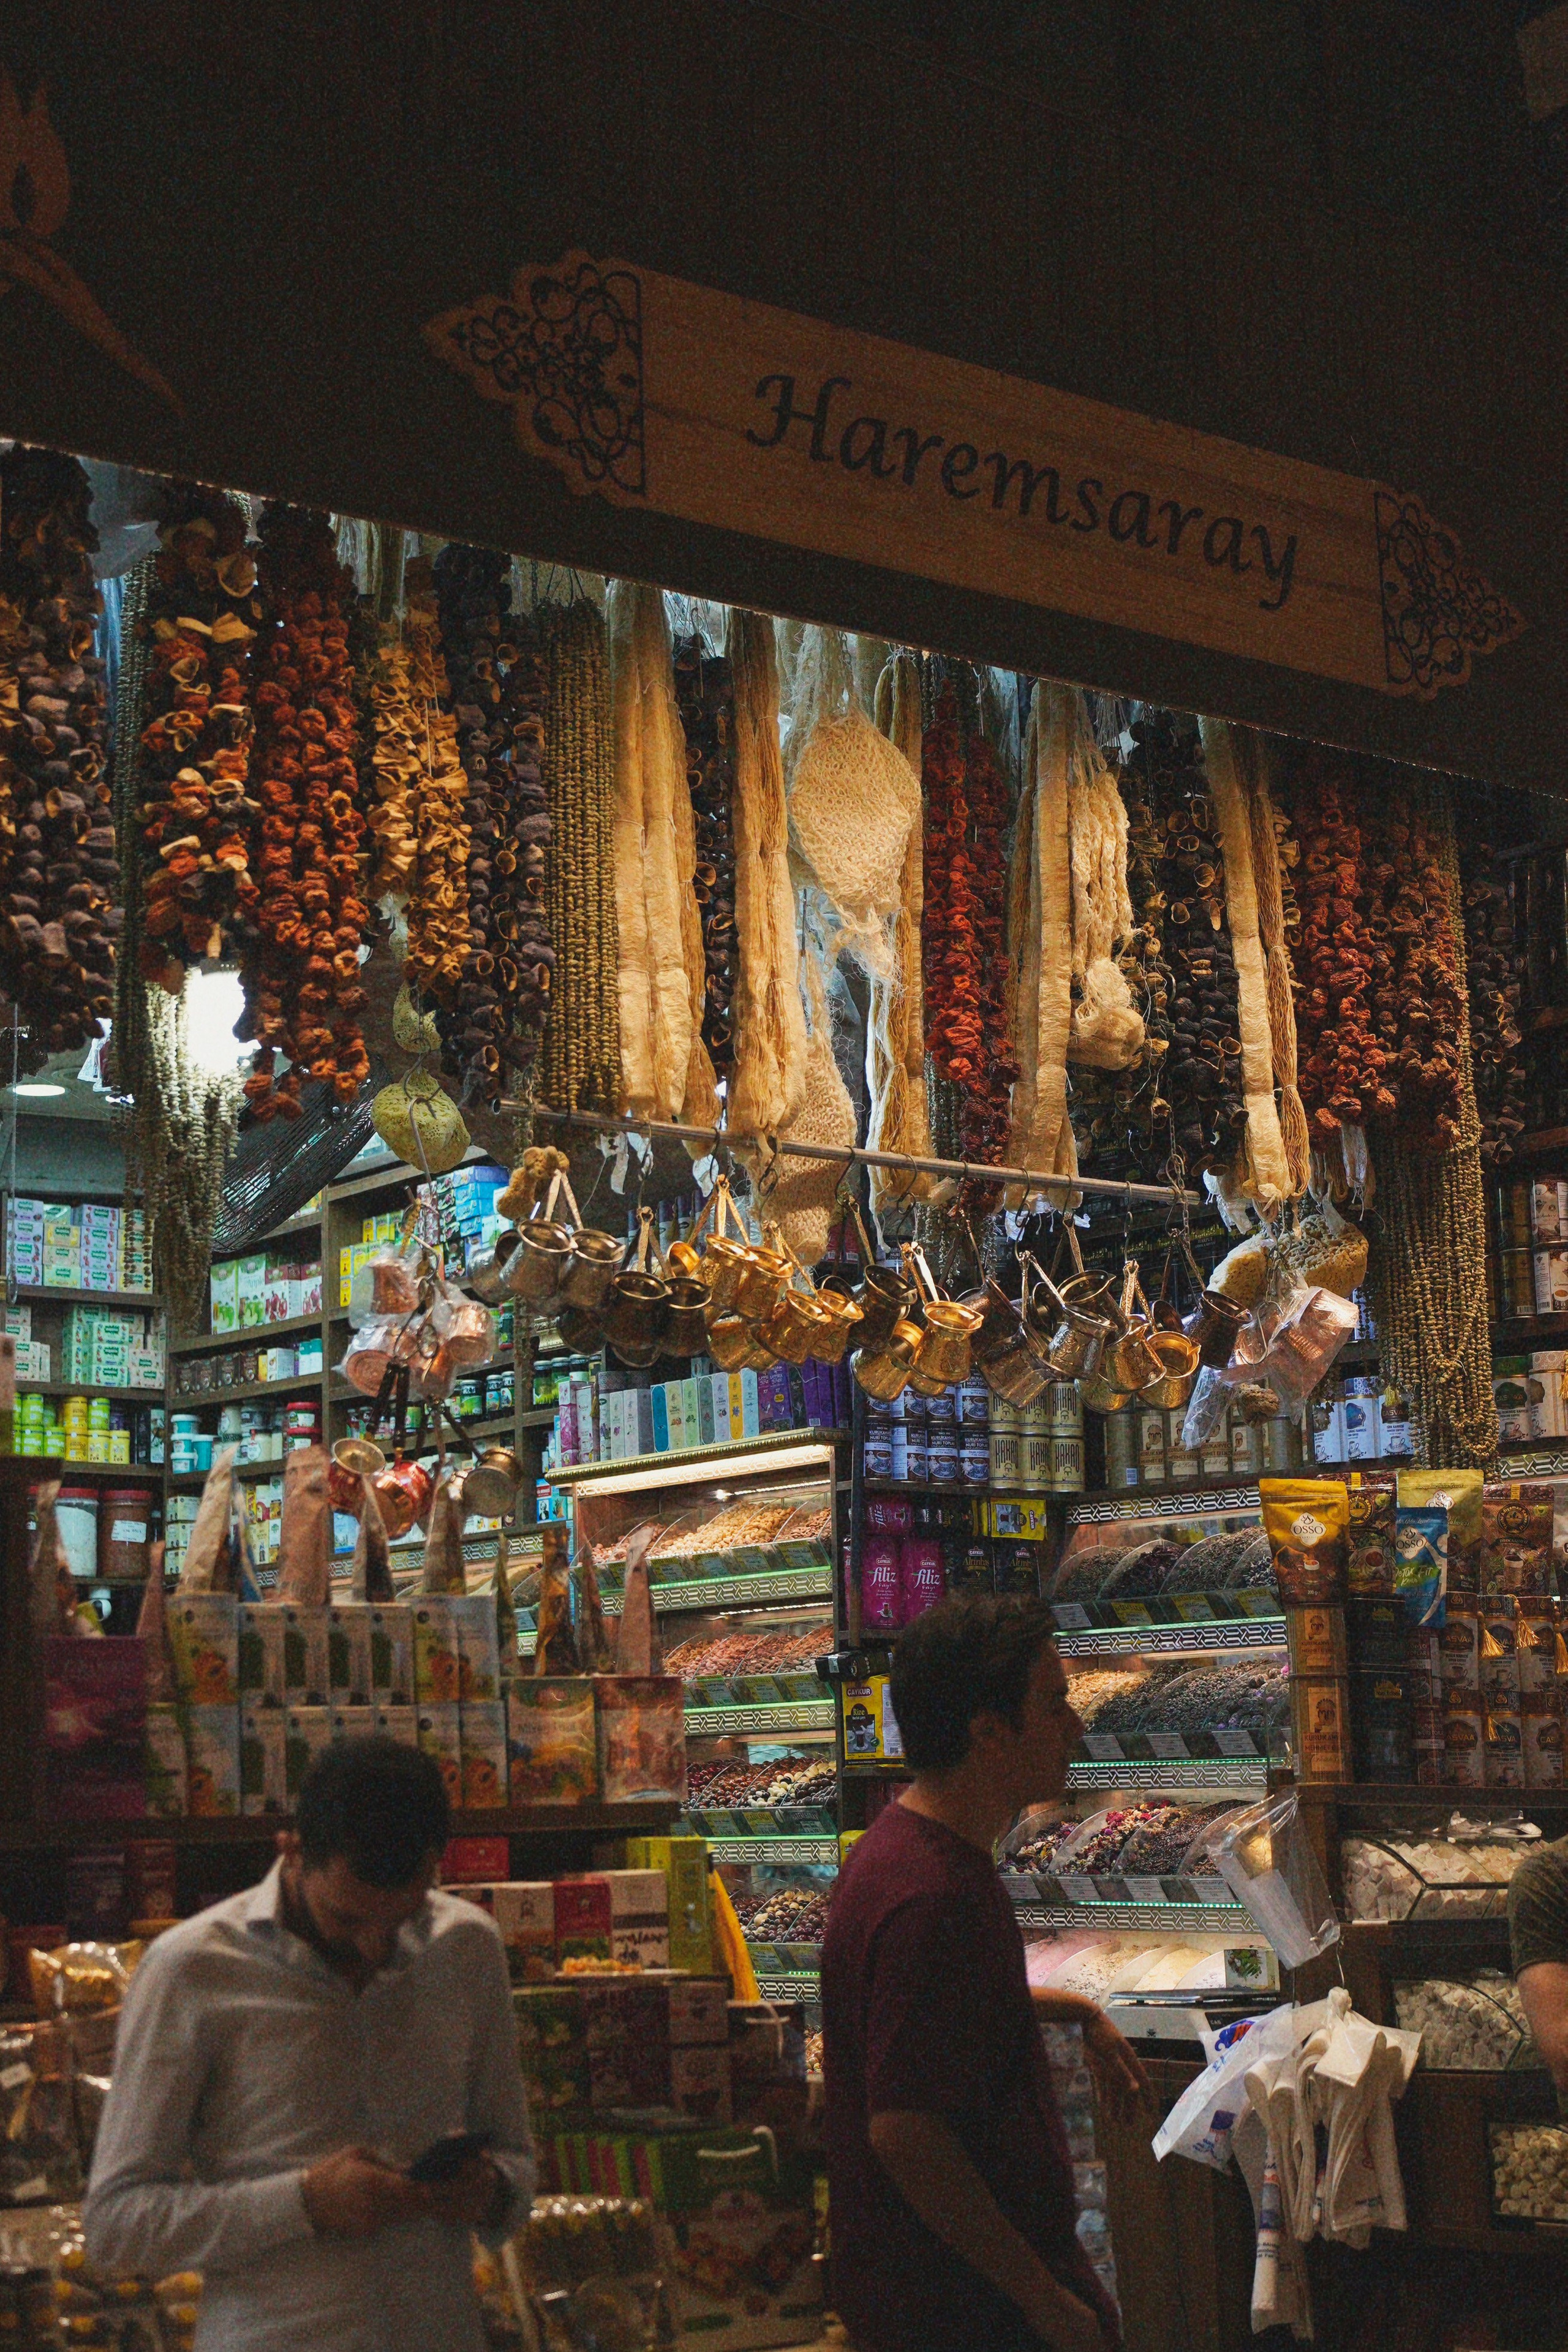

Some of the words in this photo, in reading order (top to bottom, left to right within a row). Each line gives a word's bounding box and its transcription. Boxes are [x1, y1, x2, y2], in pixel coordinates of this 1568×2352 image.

[745, 374, 1295, 609] Haremsaray
[995, 1439, 1018, 1469] KAKAO
[1055, 1444, 1080, 1472] KAKAO
[1293, 1525, 1323, 1534] OSSO
[1396, 1539, 1423, 1548] OSSO
[870, 1566, 896, 1586] filiz
[914, 1569, 940, 1589] filiz
